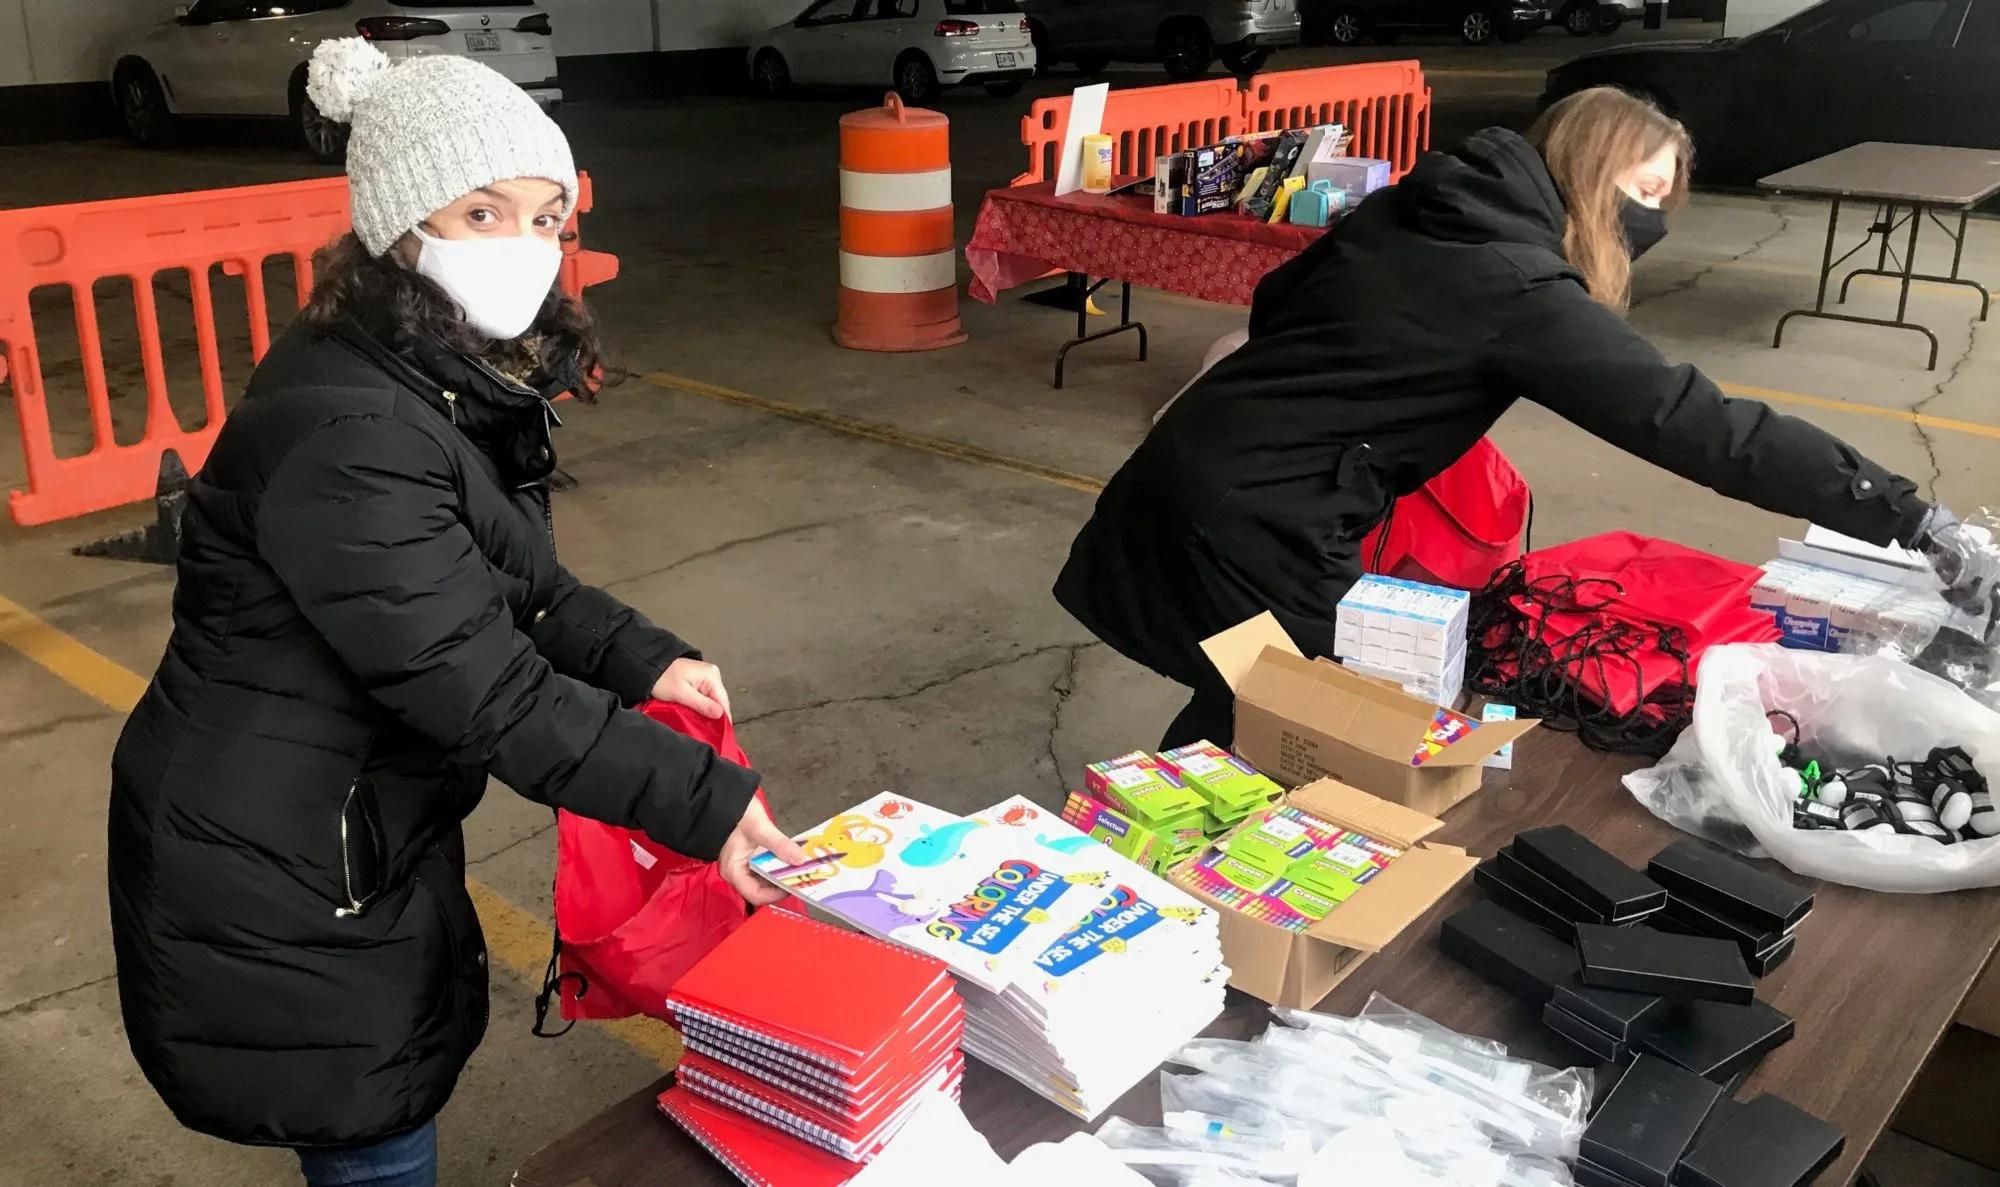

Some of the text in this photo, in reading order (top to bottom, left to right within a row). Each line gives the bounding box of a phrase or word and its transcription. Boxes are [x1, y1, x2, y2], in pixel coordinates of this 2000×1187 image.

[1205, 771, 1237, 785] Crayons
[1130, 783, 1166, 798] Crayons
[1097, 814, 1126, 835] Selectum
[1227, 859, 1266, 880] Crayons
[925, 858, 1041, 942] COLORING
[967, 872, 1062, 946] UNDER THE SEA
[1294, 887, 1335, 909] Crayons
[1102, 902, 1154, 934] UNDER
[1073, 928, 1100, 951] THE
[1034, 945, 1073, 968] SEA
